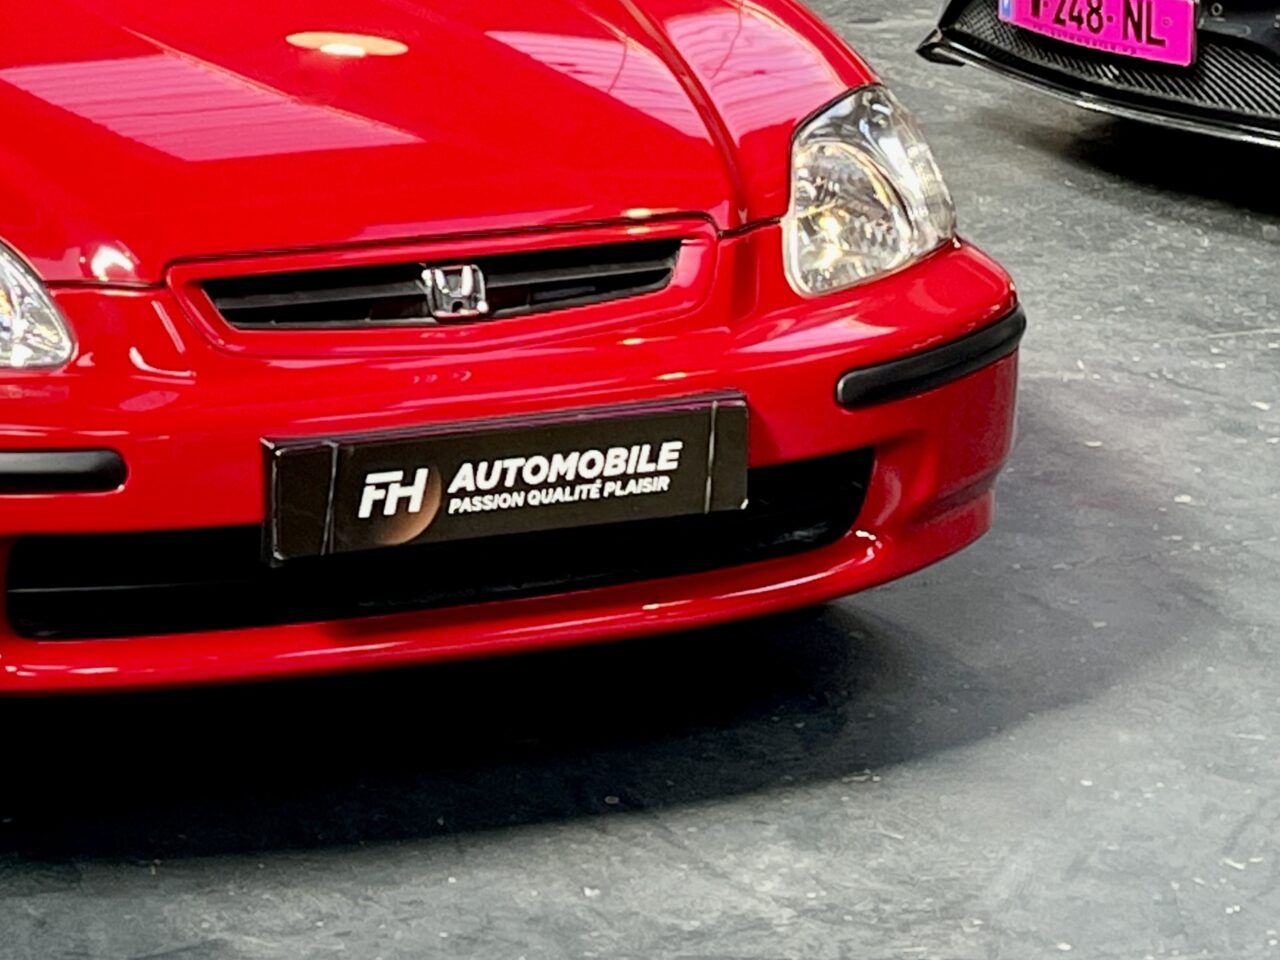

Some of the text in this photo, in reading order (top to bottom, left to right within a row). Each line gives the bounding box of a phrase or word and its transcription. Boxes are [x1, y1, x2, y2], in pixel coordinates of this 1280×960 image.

[357, 467, 429, 519] FH
[447, 440, 683, 494] AUTOMOBILE
[447, 475, 671, 515] PASSION QUALITÉ PLAISIR
